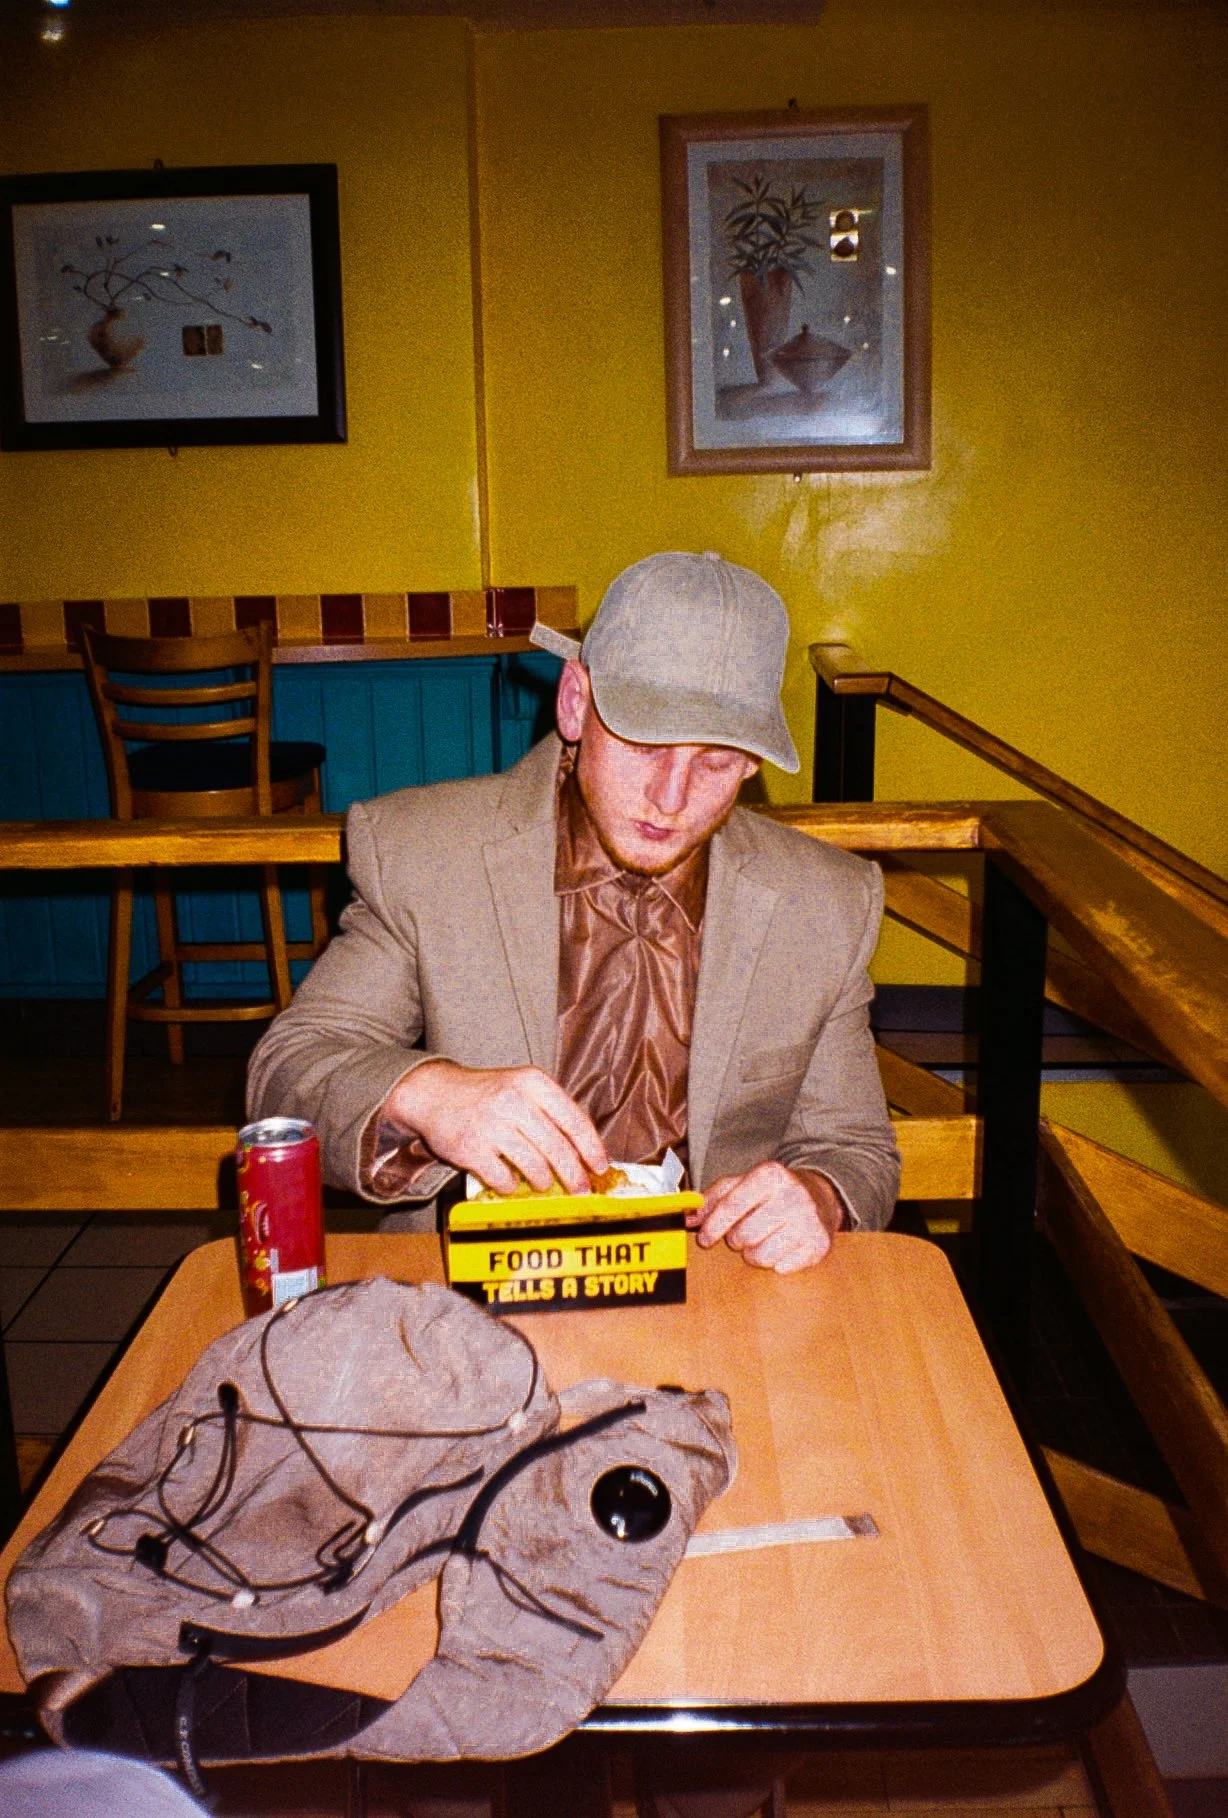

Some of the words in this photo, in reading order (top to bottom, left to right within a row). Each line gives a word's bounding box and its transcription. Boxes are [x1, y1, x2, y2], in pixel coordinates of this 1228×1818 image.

[489, 1248, 563, 1273] FOOD
[575, 1241, 651, 1267] THAT
[482, 1278, 555, 1304] TELLS
[562, 1277, 578, 1299] A
[584, 1271, 659, 1297] STORY
